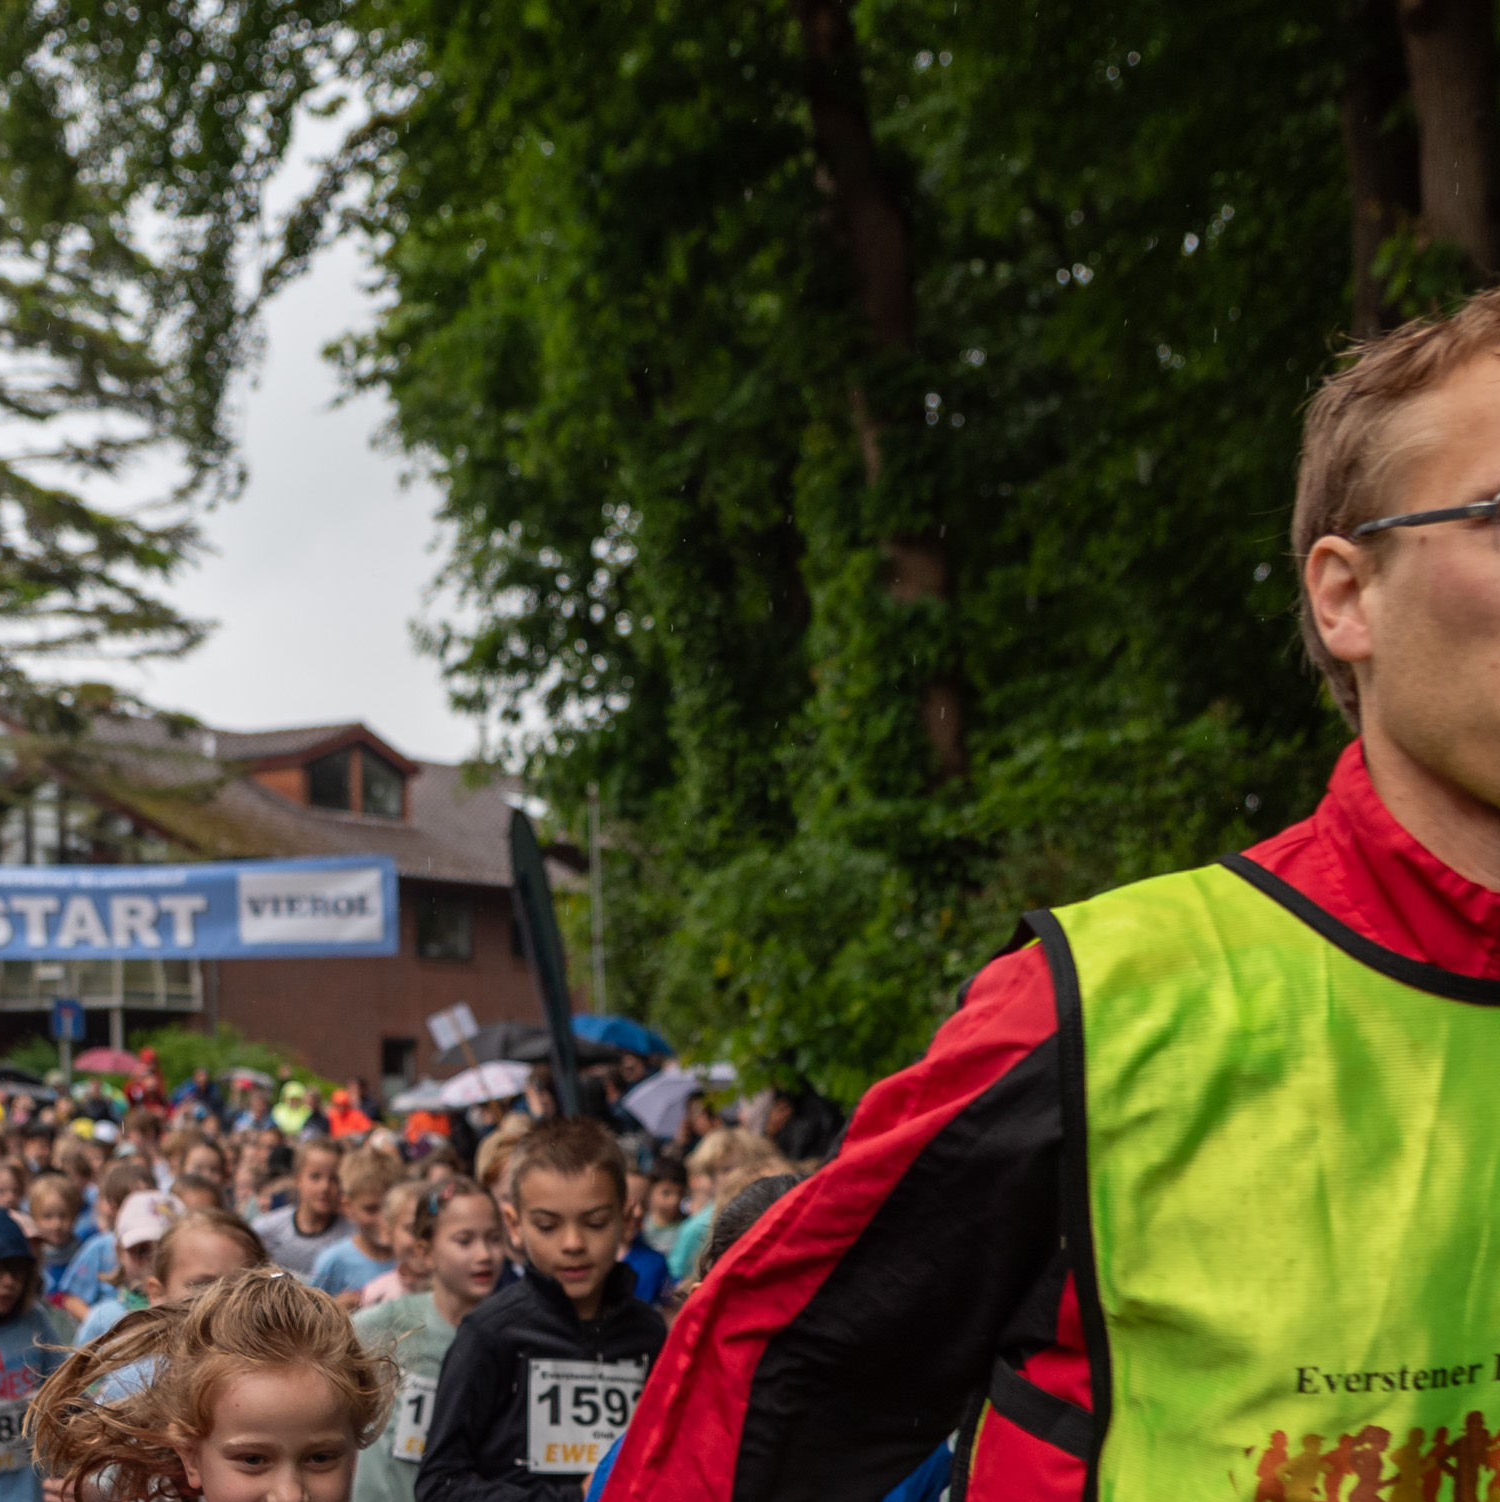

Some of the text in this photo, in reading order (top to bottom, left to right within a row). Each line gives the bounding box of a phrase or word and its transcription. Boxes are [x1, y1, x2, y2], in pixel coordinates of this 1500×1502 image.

[247, 892, 375, 918] VIEROL
[1295, 1363, 1483, 1396] Everstener
[538, 1384, 642, 1427] 159
[545, 1443, 598, 1463] EWE
